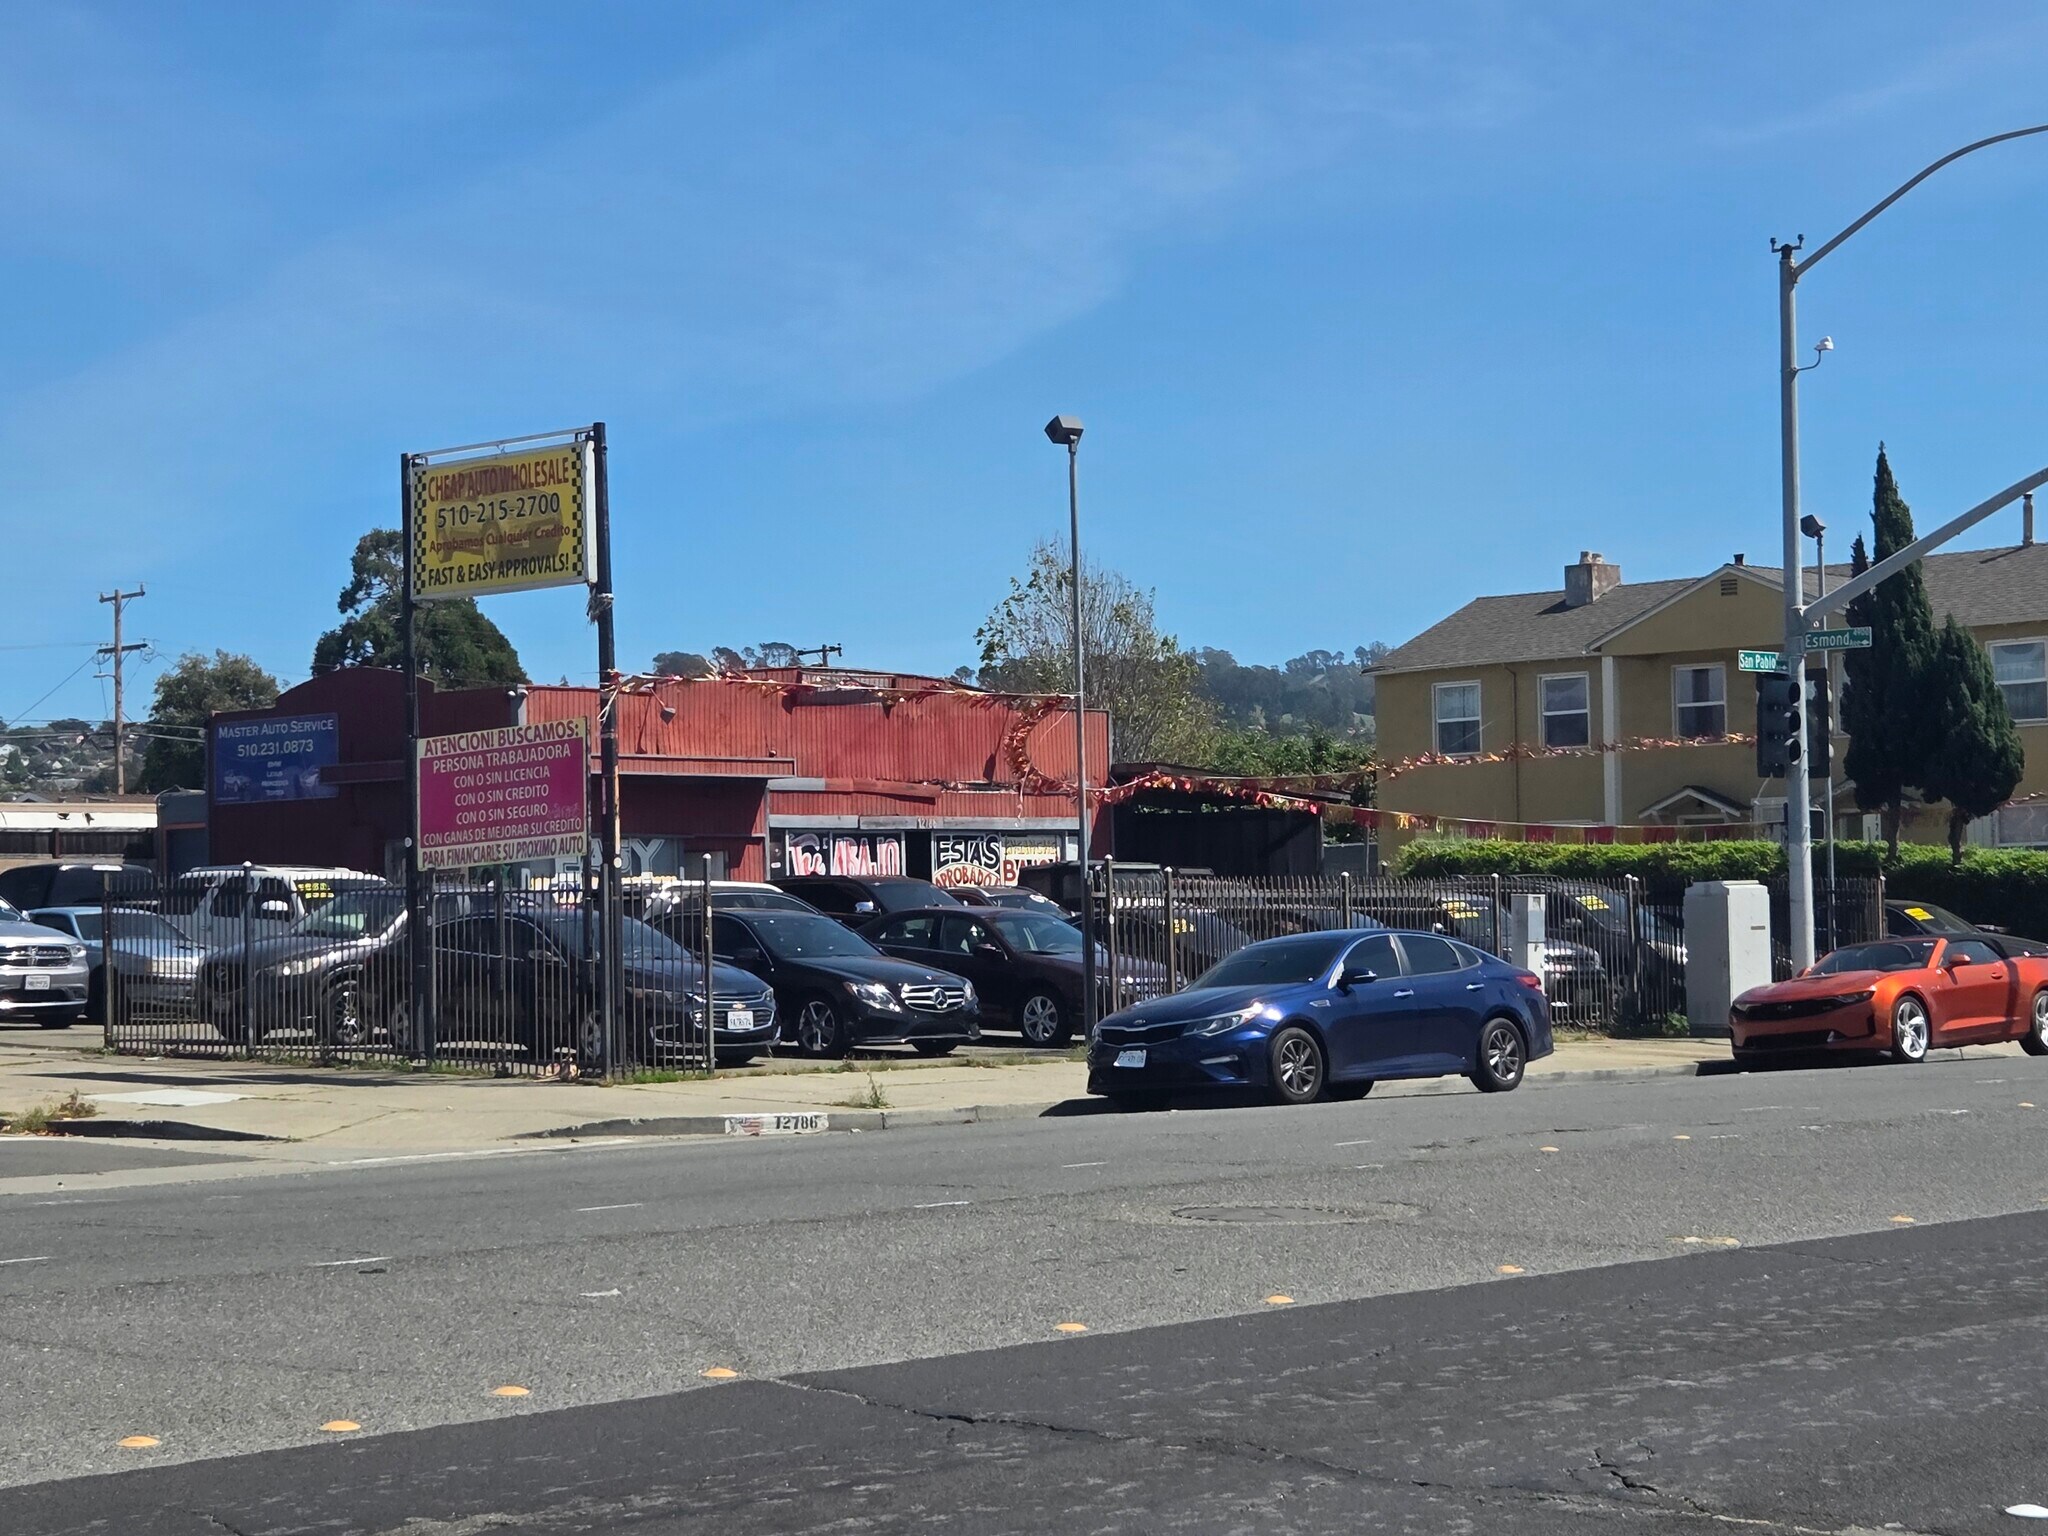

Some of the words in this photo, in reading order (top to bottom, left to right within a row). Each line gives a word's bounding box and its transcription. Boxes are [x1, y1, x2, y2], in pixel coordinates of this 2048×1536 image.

[428, 473, 464, 502] CHEAP
[469, 469, 498, 496] AUTO
[498, 457, 569, 492] WHOLESALE
[437, 493, 560, 528] 510-215-2700
[430, 534, 484, 553] Aprobamos
[486, 528, 532, 546] Cualquier
[535, 525, 570, 540] Credito
[428, 568, 454, 586] FAST
[457, 566, 465, 583] &
[469, 562, 496, 581] EASY
[498, 554, 569, 579] APPROVALS!
[1805, 632, 1850, 648] Esmond
[1739, 653, 1753, 668] San
[1755, 654, 1776, 669] Pablo
[237, 740, 314, 757] 510.231.0873
[425, 732, 494, 756] ATENCION!
[498, 722, 579, 746] BUSCAMOS:
[433, 755, 483, 774] PERSONA
[487, 743, 571, 766] TRABAJADORA
[454, 776, 474, 788] CON
[476, 774, 484, 786] O
[486, 772, 501, 785] SIN
[505, 766, 550, 783] LICENCIA
[455, 794, 475, 806] CON
[477, 792, 484, 804] O
[487, 790, 503, 802] SIN
[506, 784, 548, 801] CREDITO
[456, 812, 476, 825] CON
[479, 811, 486, 823] O
[489, 809, 504, 821] SIN
[507, 803, 548, 819] SEGURO
[424, 833, 442, 846] CON
[445, 830, 473, 843] GANAS
[475, 828, 486, 840] DE
[488, 825, 529, 839] MEJORAR
[531, 823, 542, 834] SU
[544, 818, 581, 834] CREDITO
[423, 850, 445, 866] PARA
[447, 844, 501, 864] FINANCIARLE
[503, 842, 514, 860] SU
[516, 839, 557, 858] PROXIMO
[559, 836, 583, 854] AUTO
[774, 1115, 818, 1130] 12786
